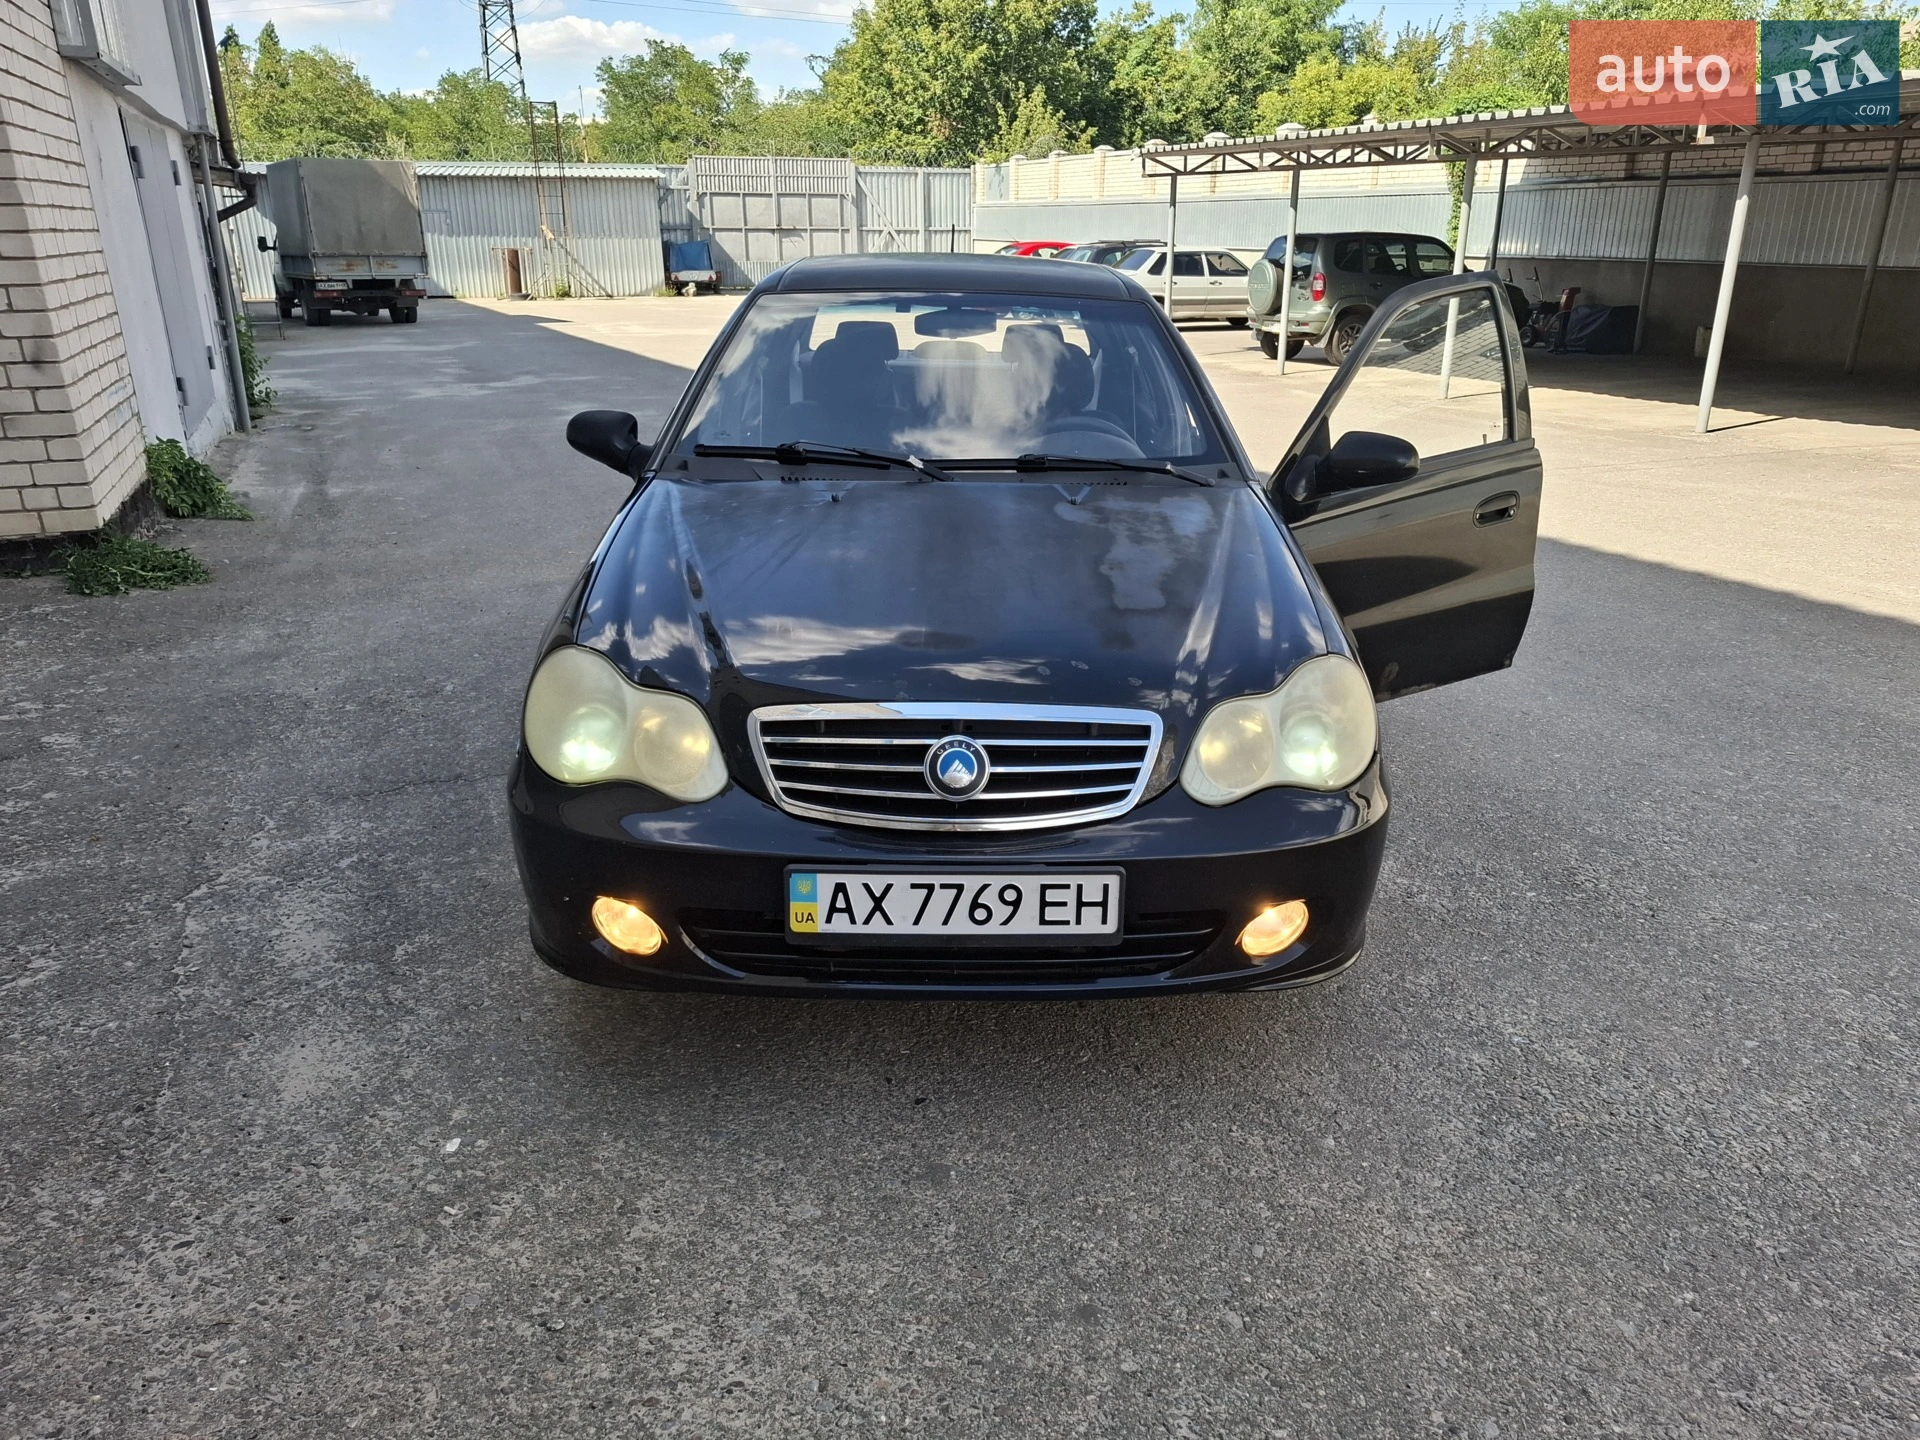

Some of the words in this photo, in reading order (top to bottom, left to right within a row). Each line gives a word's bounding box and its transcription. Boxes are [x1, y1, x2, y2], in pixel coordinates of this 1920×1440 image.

[936, 741, 976, 755] GEELY
[825, 882, 894, 925] AX
[910, 883, 1024, 926] 7769
[1038, 883, 1110, 926] EH
[795, 912, 815, 923] UA
